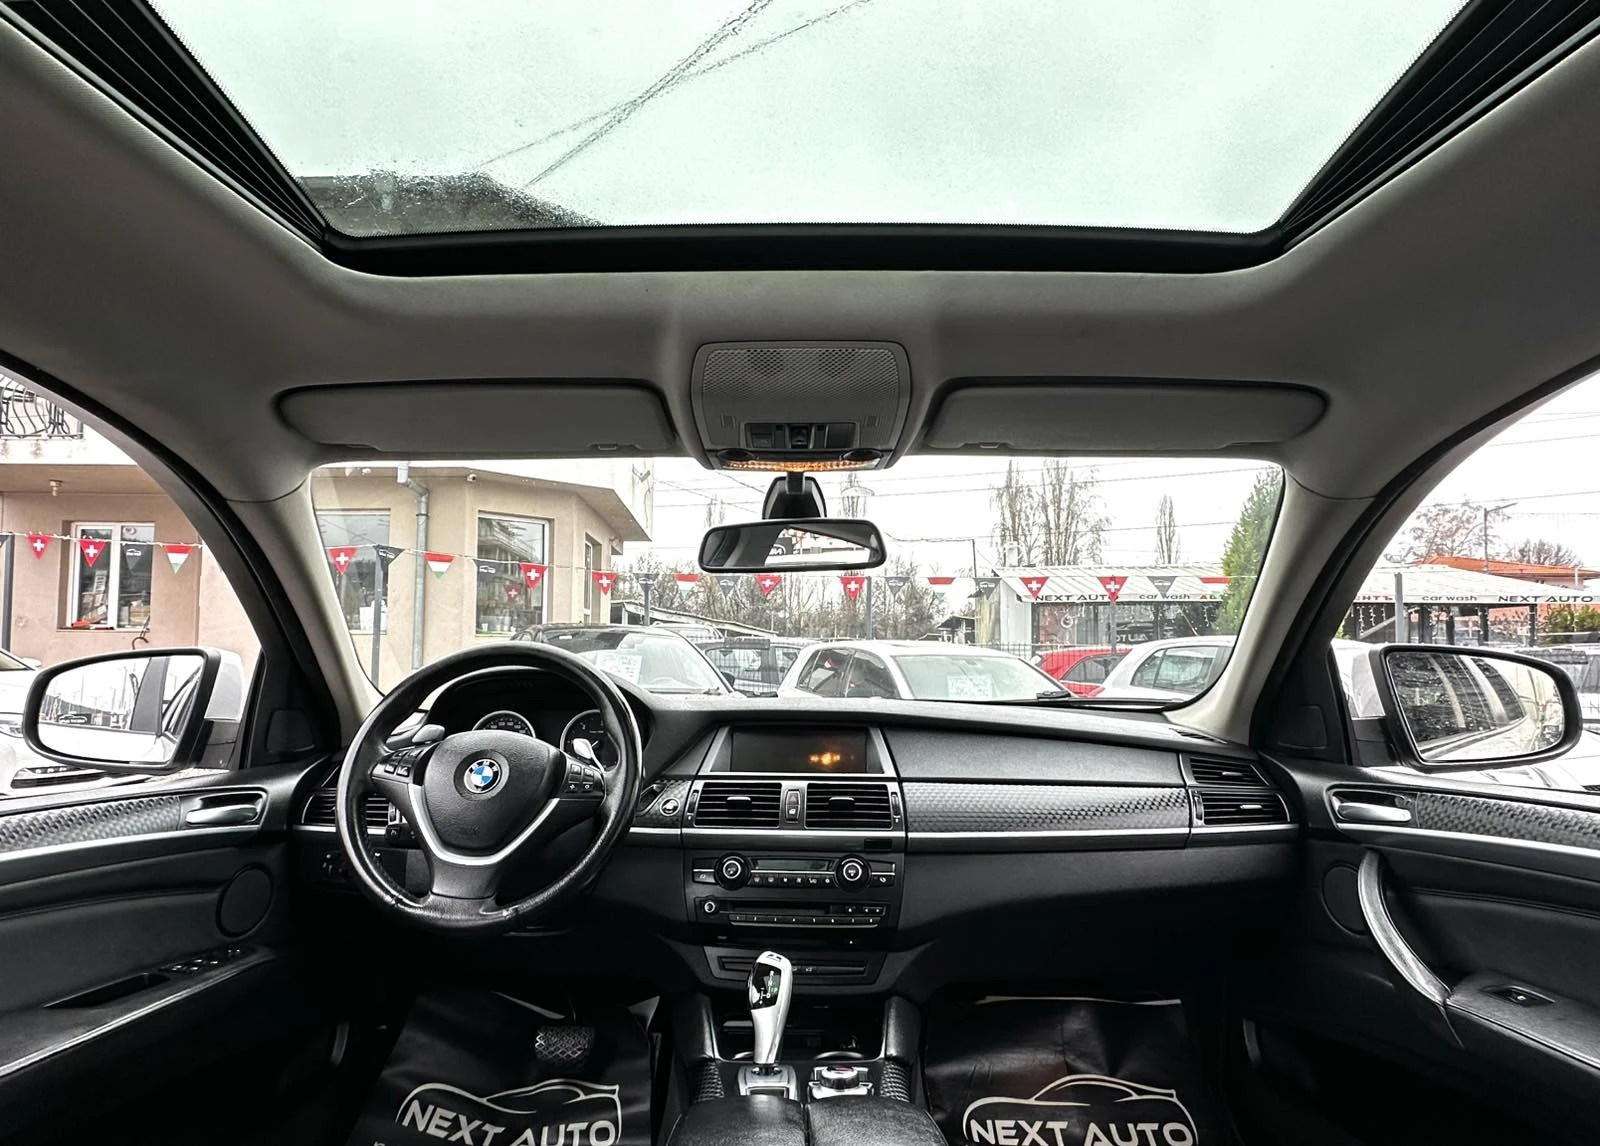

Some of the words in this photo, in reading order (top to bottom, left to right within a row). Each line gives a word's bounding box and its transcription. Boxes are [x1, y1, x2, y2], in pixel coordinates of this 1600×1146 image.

[1035, 594, 1073, 602] NEXT
[1446, 594, 1478, 602] wash
[1498, 595, 1541, 603] NEXT
[1545, 595, 1594, 603] AUTO
[402, 1099, 505, 1146] NEXT
[508, 1119, 616, 1146] AUTO
[970, 1119, 1069, 1146] NEXT
[1084, 1122, 1193, 1146] AUTO
